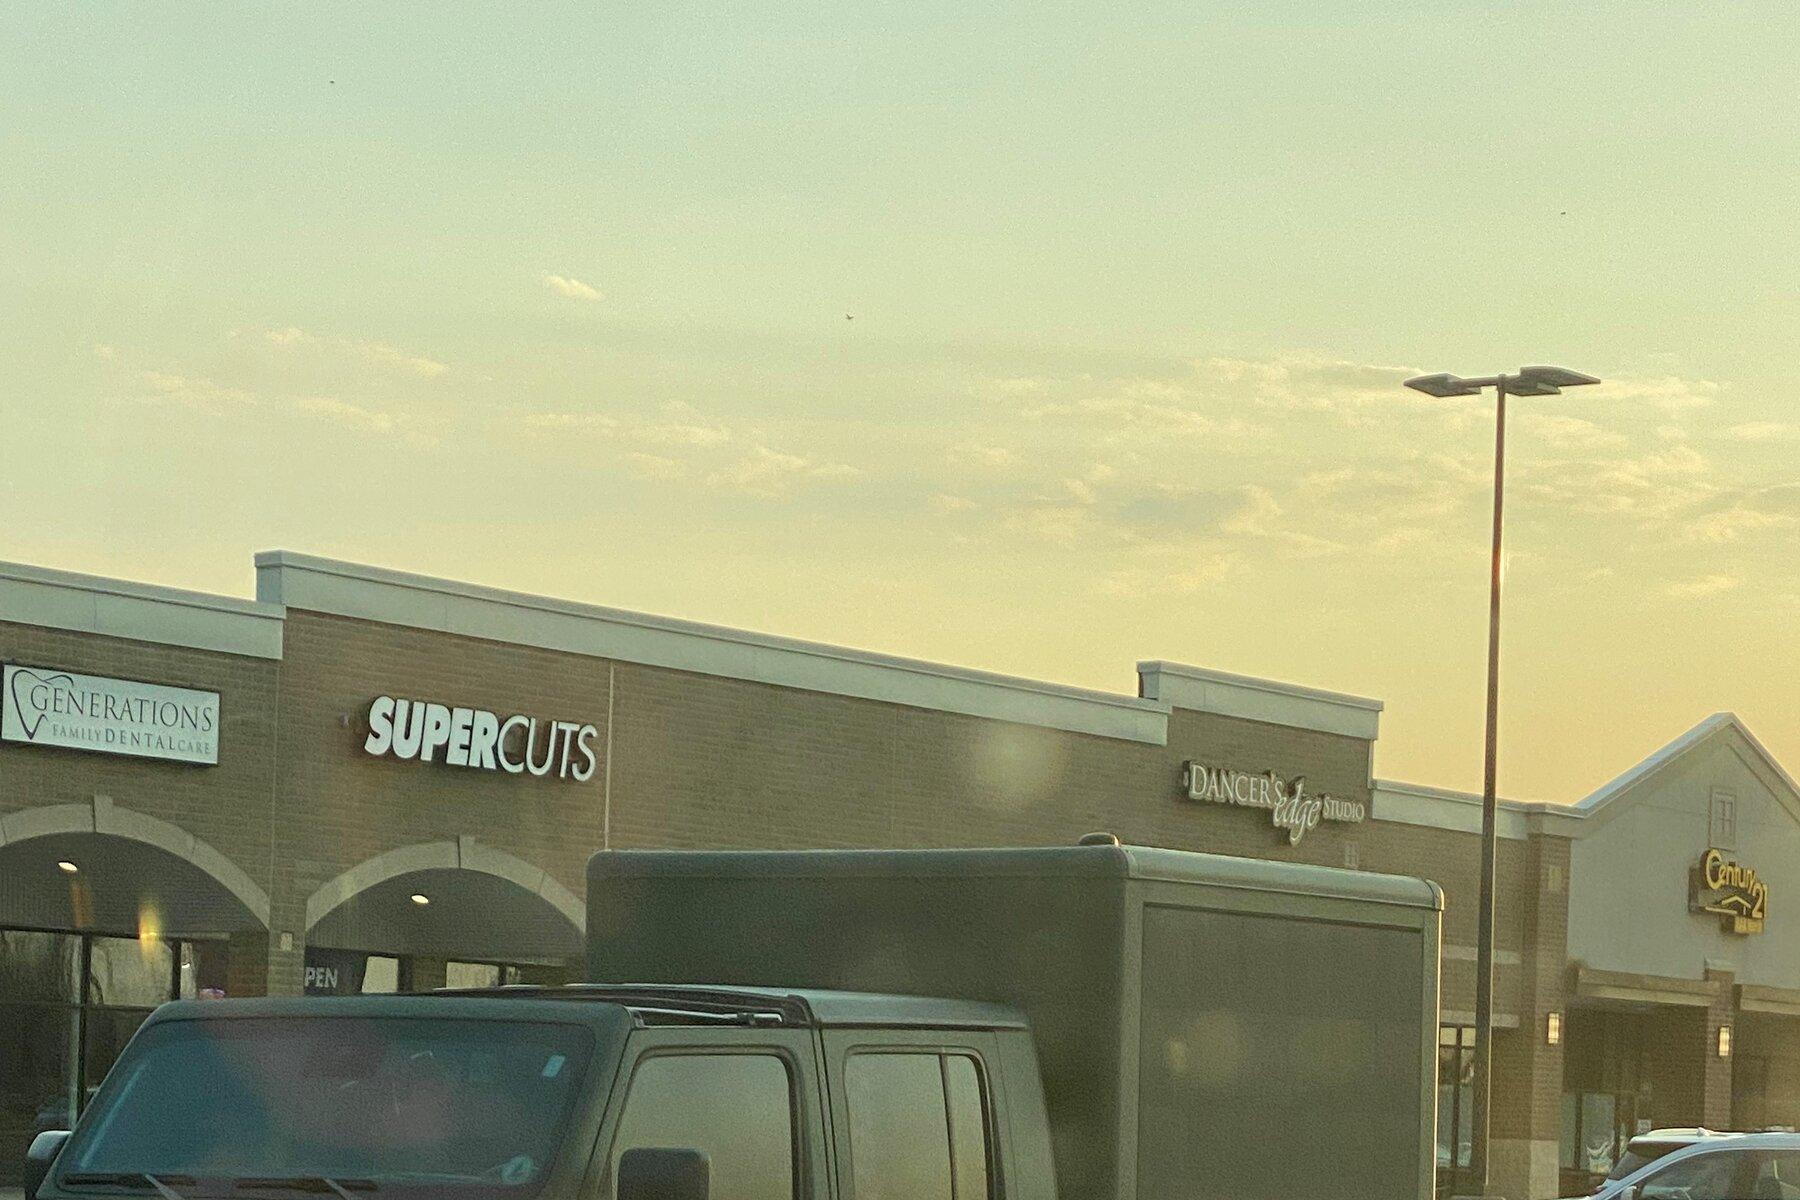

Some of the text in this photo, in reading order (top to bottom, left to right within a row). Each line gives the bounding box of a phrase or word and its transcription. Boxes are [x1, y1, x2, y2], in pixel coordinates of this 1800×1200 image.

[30, 684, 213, 732] GENERATIONS
[53, 724, 211, 755] FAMILY DENTAL CARE
[364, 695, 598, 782] SUPERCUTS
[1188, 763, 1365, 845] DANCER'S edge STUDIO
[1705, 848, 1757, 894] Century
[1752, 882, 1768, 919] 21
[304, 966, 338, 989] PEN
